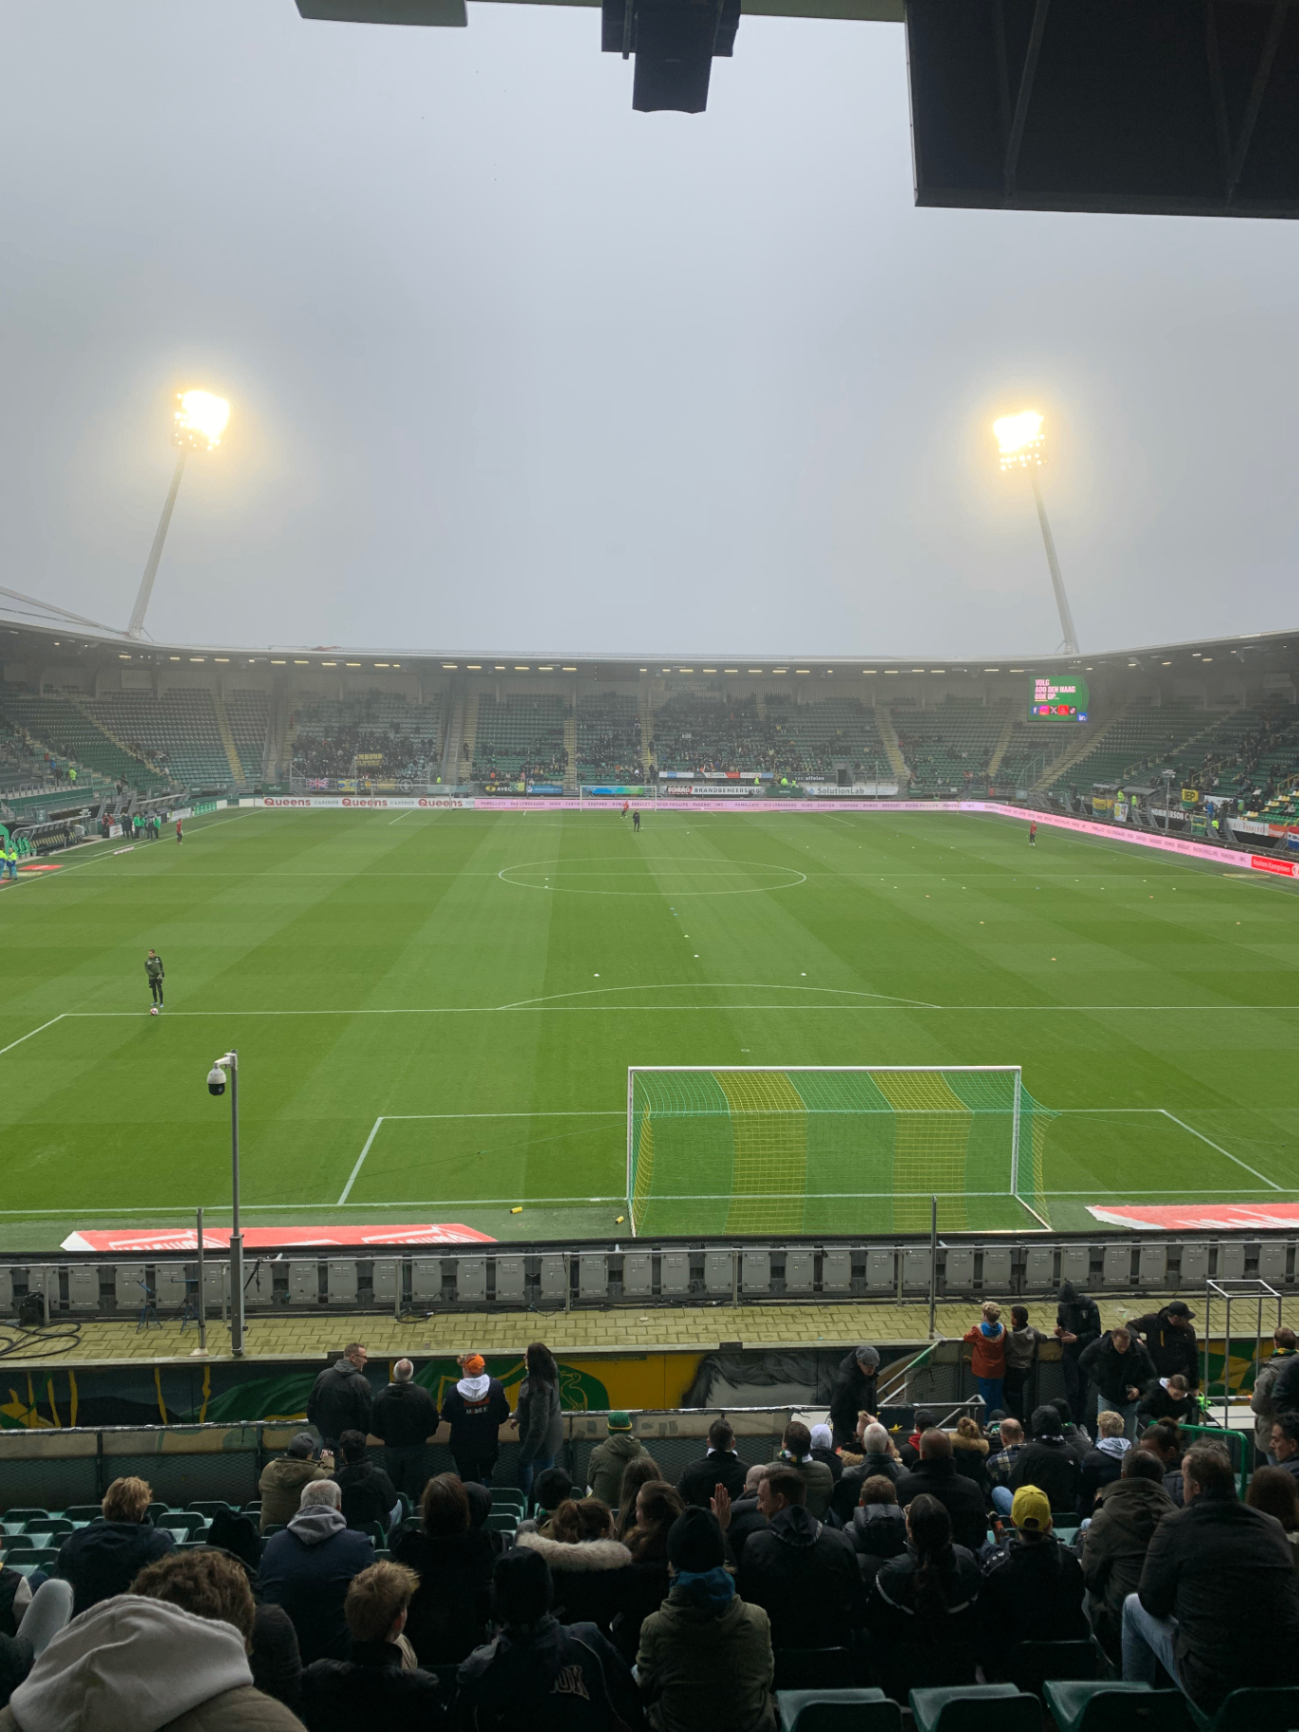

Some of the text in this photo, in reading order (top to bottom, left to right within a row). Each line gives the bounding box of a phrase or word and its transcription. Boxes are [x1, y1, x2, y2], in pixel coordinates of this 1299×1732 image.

[817, 787, 865, 795] SolutionLab
[263, 797, 311, 807] Queens
[341, 797, 388, 807] Queens
[418, 798, 463, 807] Queens
